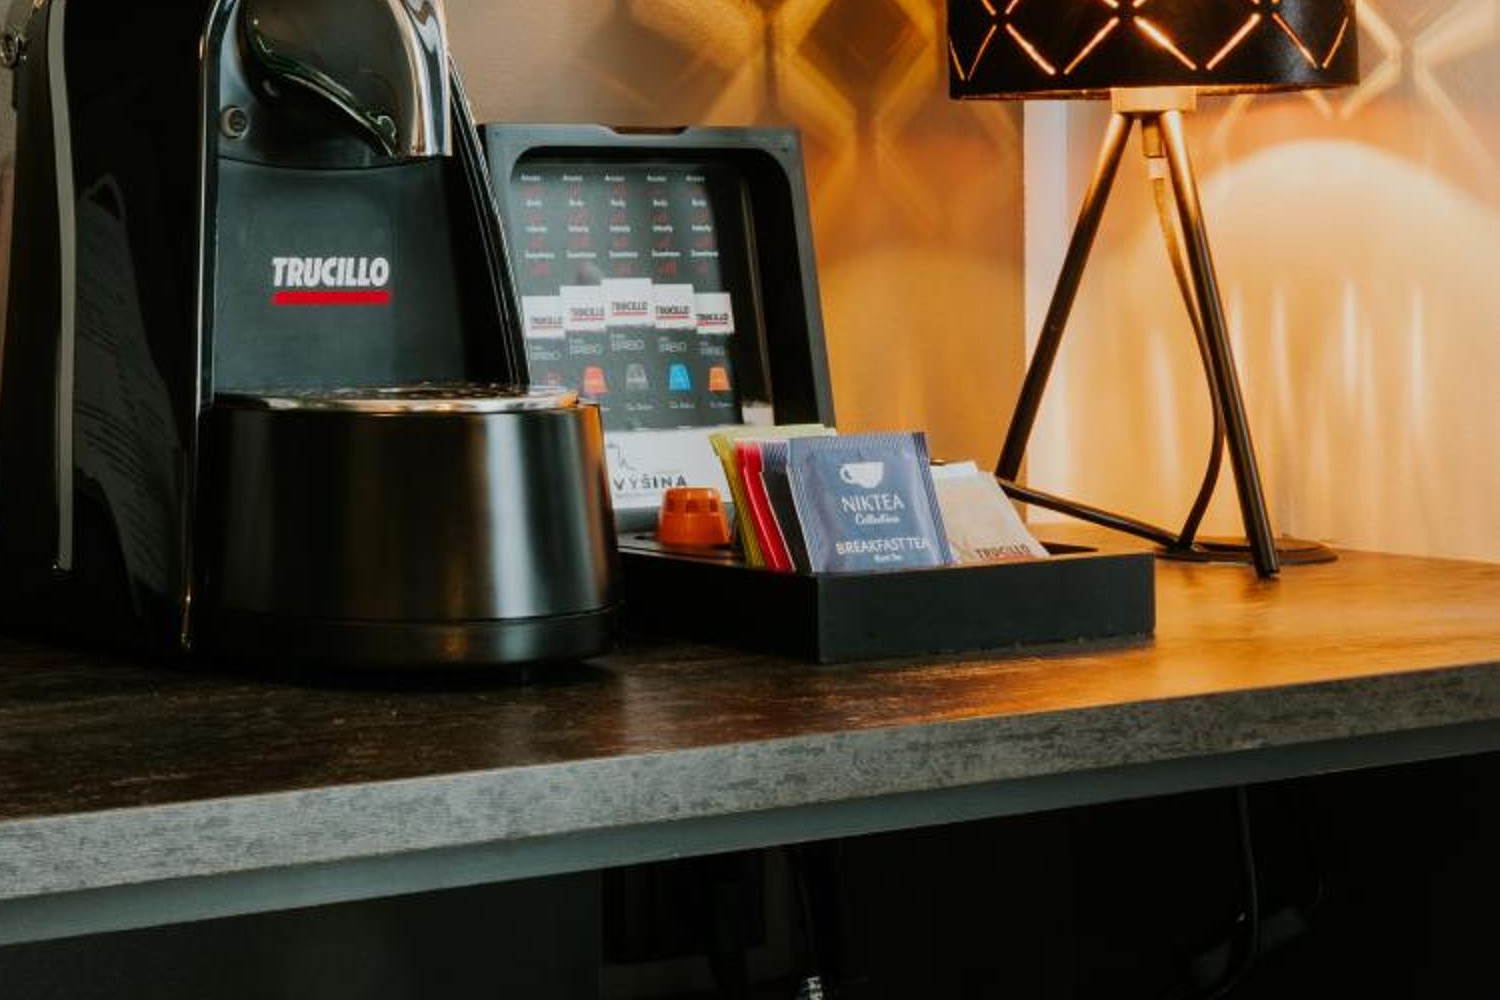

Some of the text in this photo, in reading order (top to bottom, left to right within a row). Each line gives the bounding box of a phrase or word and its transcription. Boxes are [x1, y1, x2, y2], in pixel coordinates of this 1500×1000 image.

[272, 256, 389, 286] TRUCILLO
[841, 493, 905, 512] NIKTEA
[835, 538, 905, 556] BREAKFAST
